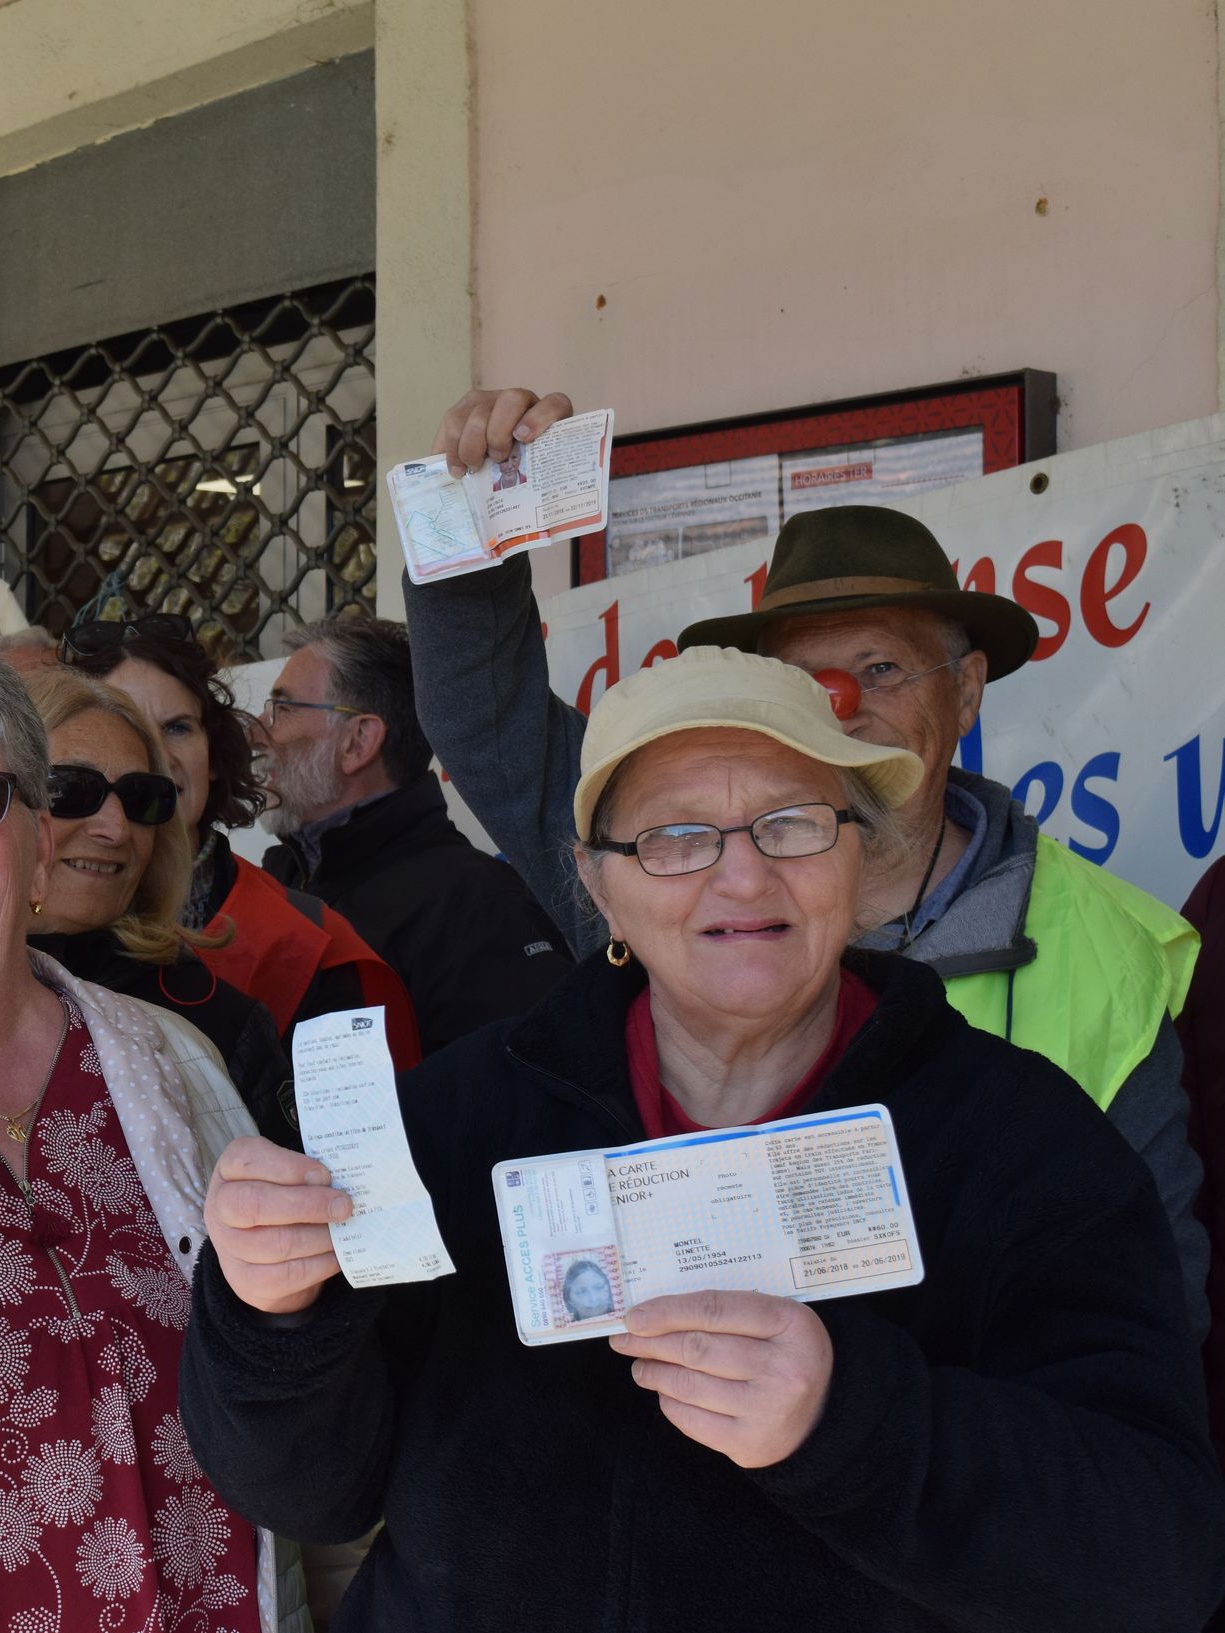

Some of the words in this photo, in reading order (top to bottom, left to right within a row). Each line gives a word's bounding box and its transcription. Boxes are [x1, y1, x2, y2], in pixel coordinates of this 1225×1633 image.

[795, 469, 846, 485] HORAIRES
[618, 1161, 657, 1176] CARTE
[618, 1167, 690, 1190] RÉDUCTION
[513, 1204, 527, 1238] PLUS
[837, 1230, 850, 1238] EUR
[673, 1237, 704, 1248] MONTEL
[675, 1244, 710, 1256] GINETTE
[519, 1240, 536, 1284] ACCES
[677, 1250, 727, 1264] 13/05/1954
[804, 1263, 849, 1277] 21/06/2018
[861, 1253, 906, 1267] 20/06/2019
[527, 1287, 541, 1329] Service
